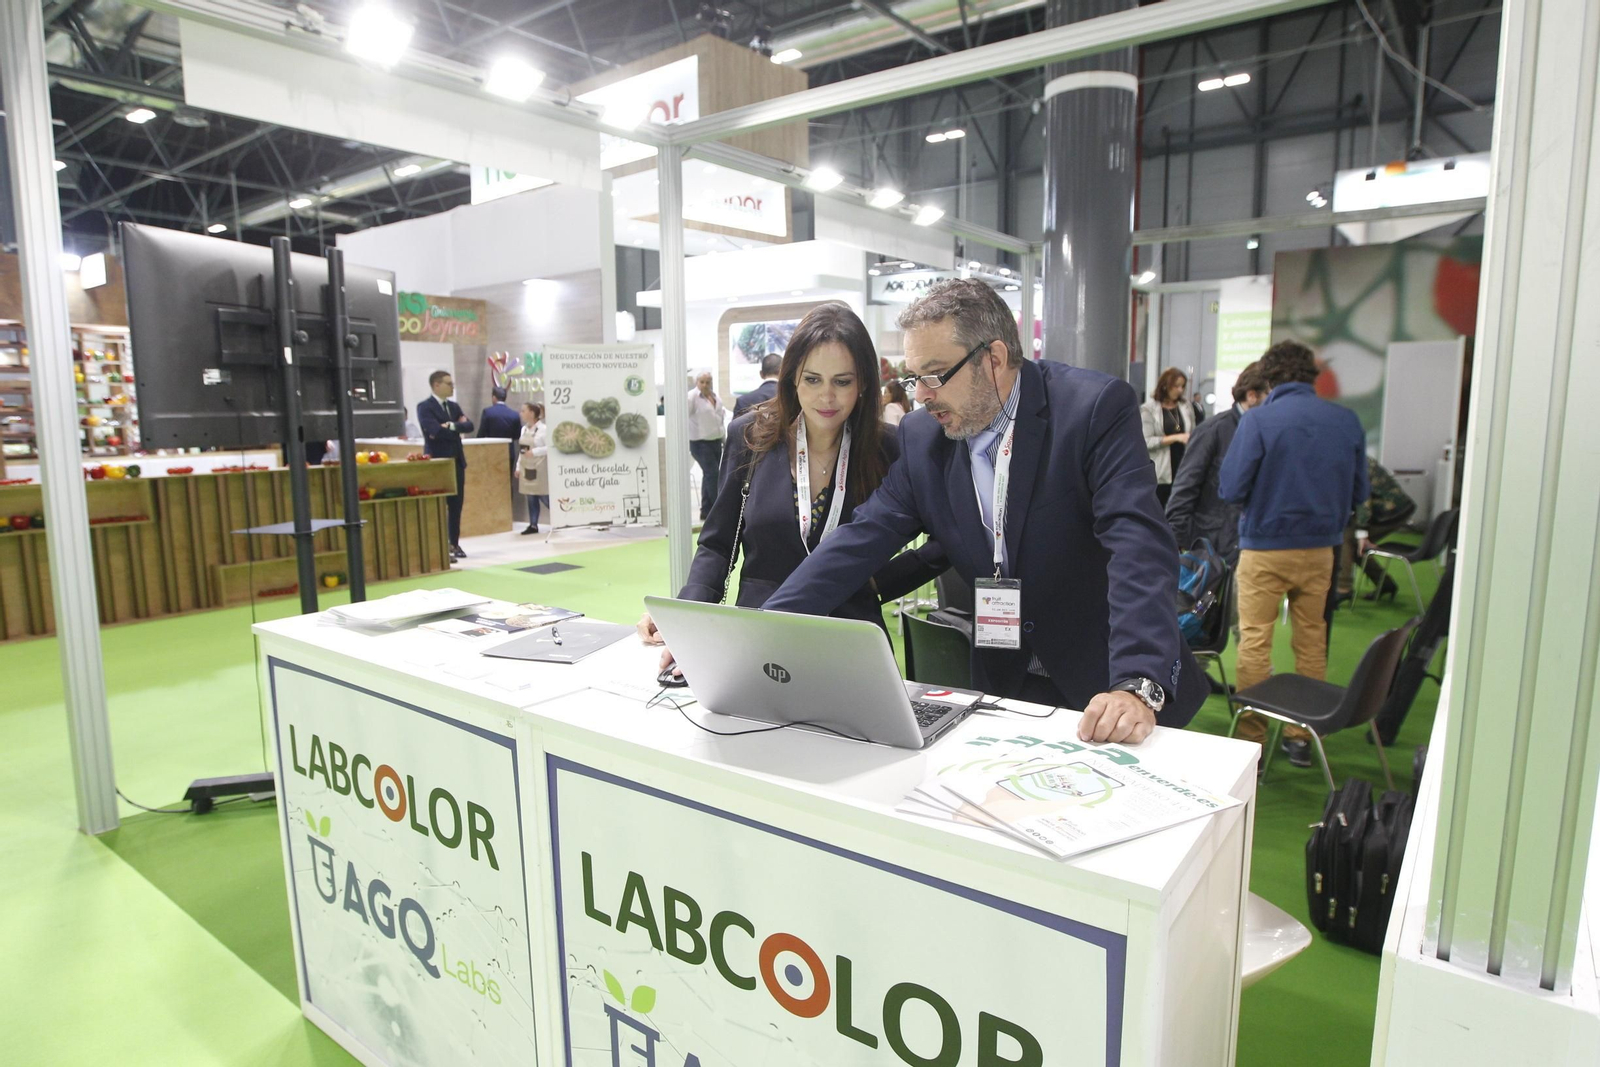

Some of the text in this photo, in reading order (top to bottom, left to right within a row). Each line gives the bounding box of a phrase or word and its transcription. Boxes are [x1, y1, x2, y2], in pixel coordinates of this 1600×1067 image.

[615, 352, 649, 360] NUESTRO
[561, 362, 601, 370] PRODUCTO
[550, 387, 572, 405] 23
[591, 463, 631, 476] Chocolate
[564, 478, 585, 489] Cabo
[766, 663, 789, 683] hp
[289, 723, 500, 872] LABCOLOR
[342, 860, 502, 1006] AGQ Labs
